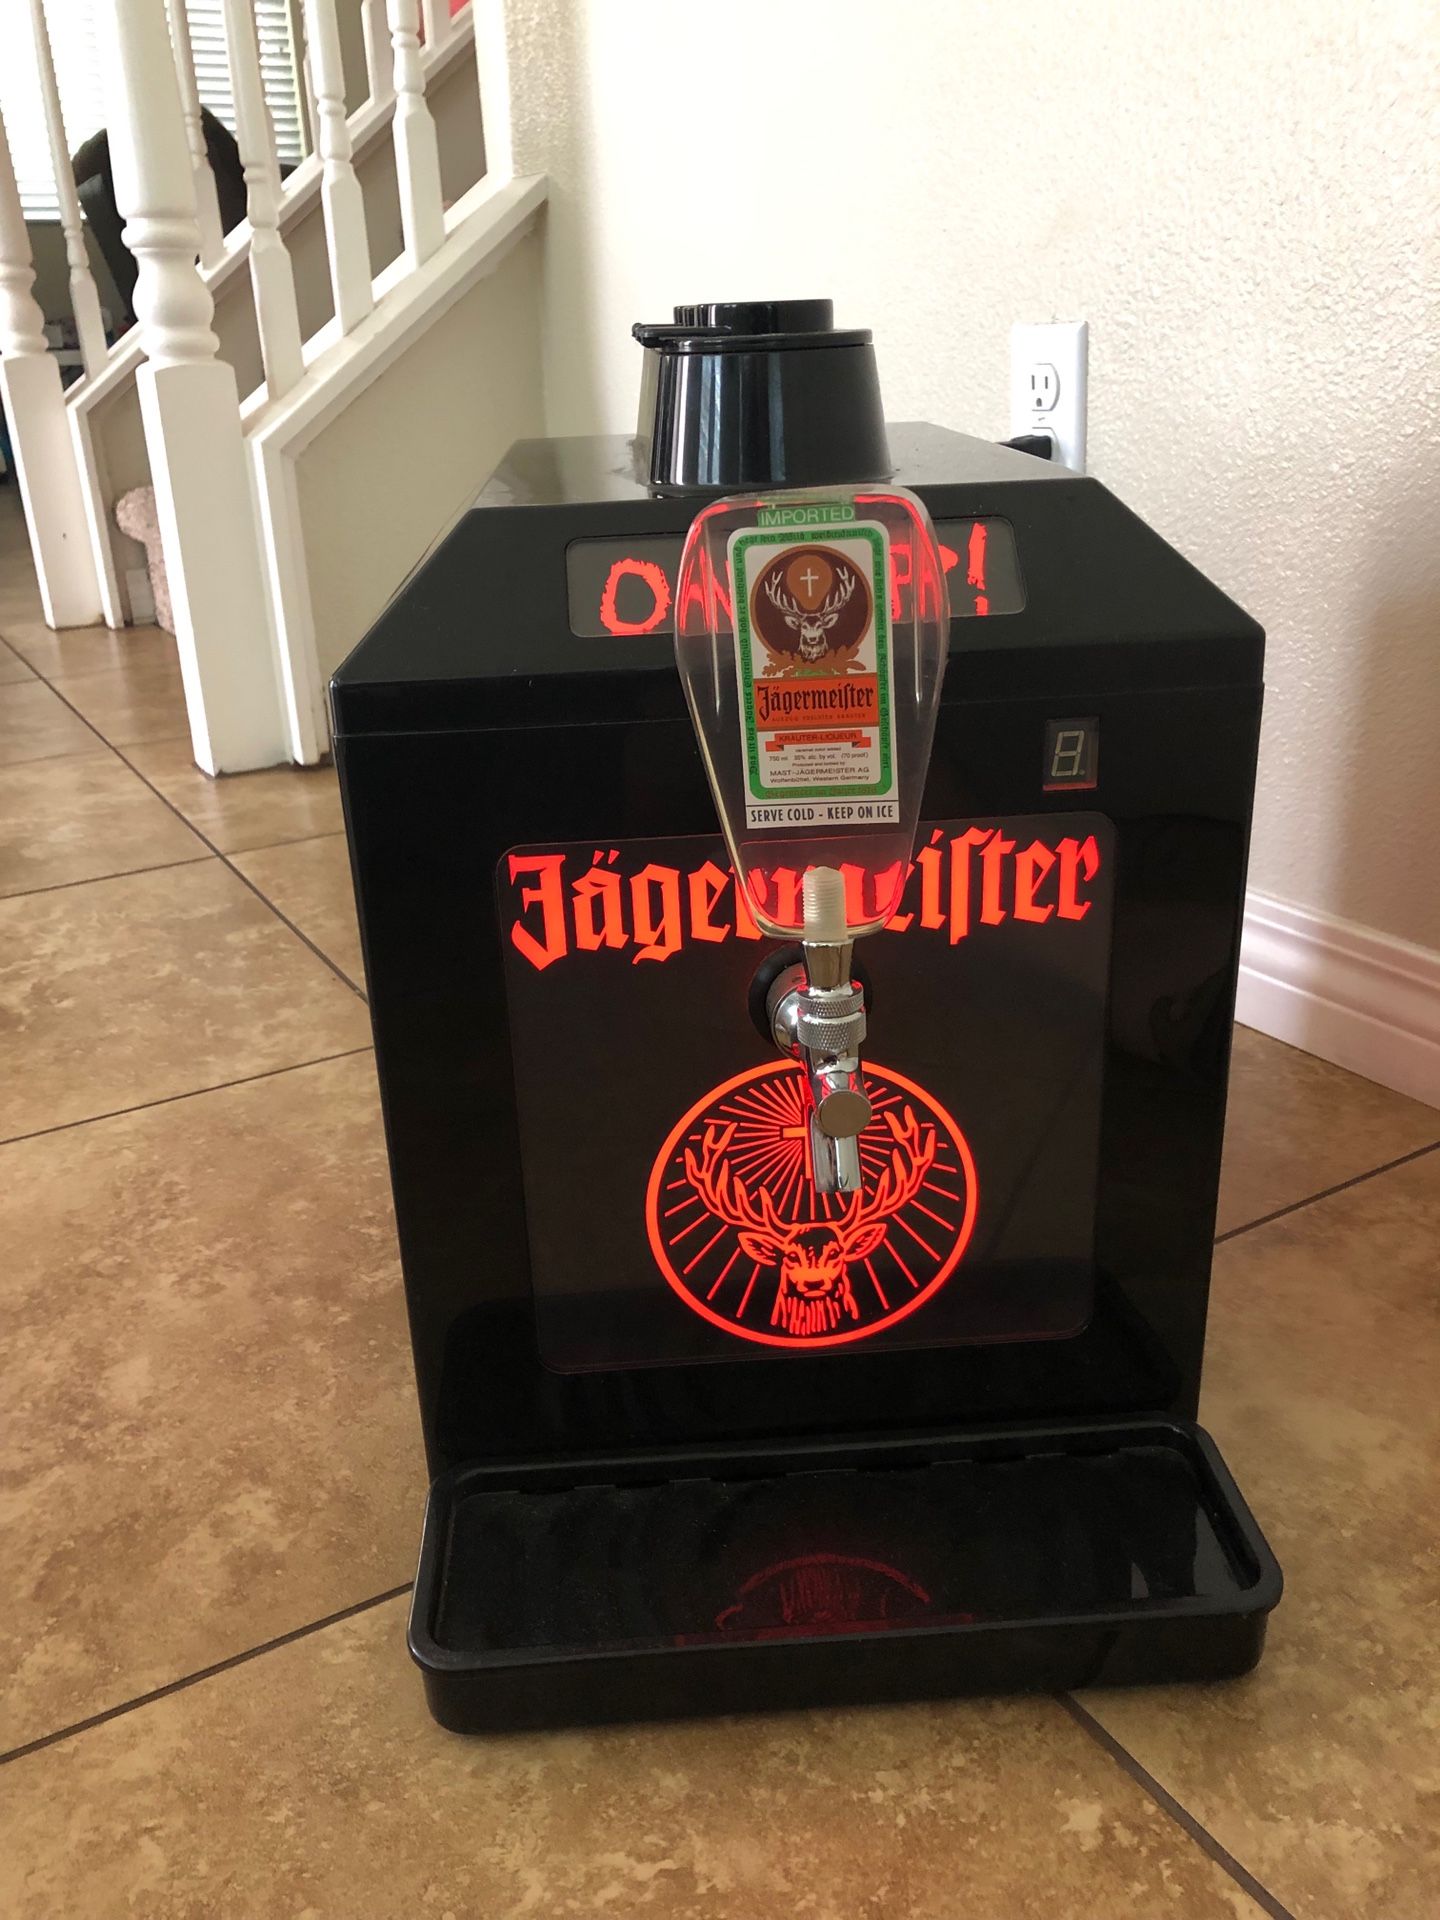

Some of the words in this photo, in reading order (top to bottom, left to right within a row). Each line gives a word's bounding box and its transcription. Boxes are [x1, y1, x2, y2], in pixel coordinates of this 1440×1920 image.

[760, 507, 854, 526] IMPORTED
[757, 683, 874, 721] Jägermeister
[858, 766, 870, 774] AG
[751, 808, 784, 823] SERVE
[787, 807, 815, 821] COLD
[827, 806, 854, 820] KEEP
[857, 805, 873, 819] ON
[876, 805, 894, 818] ICE
